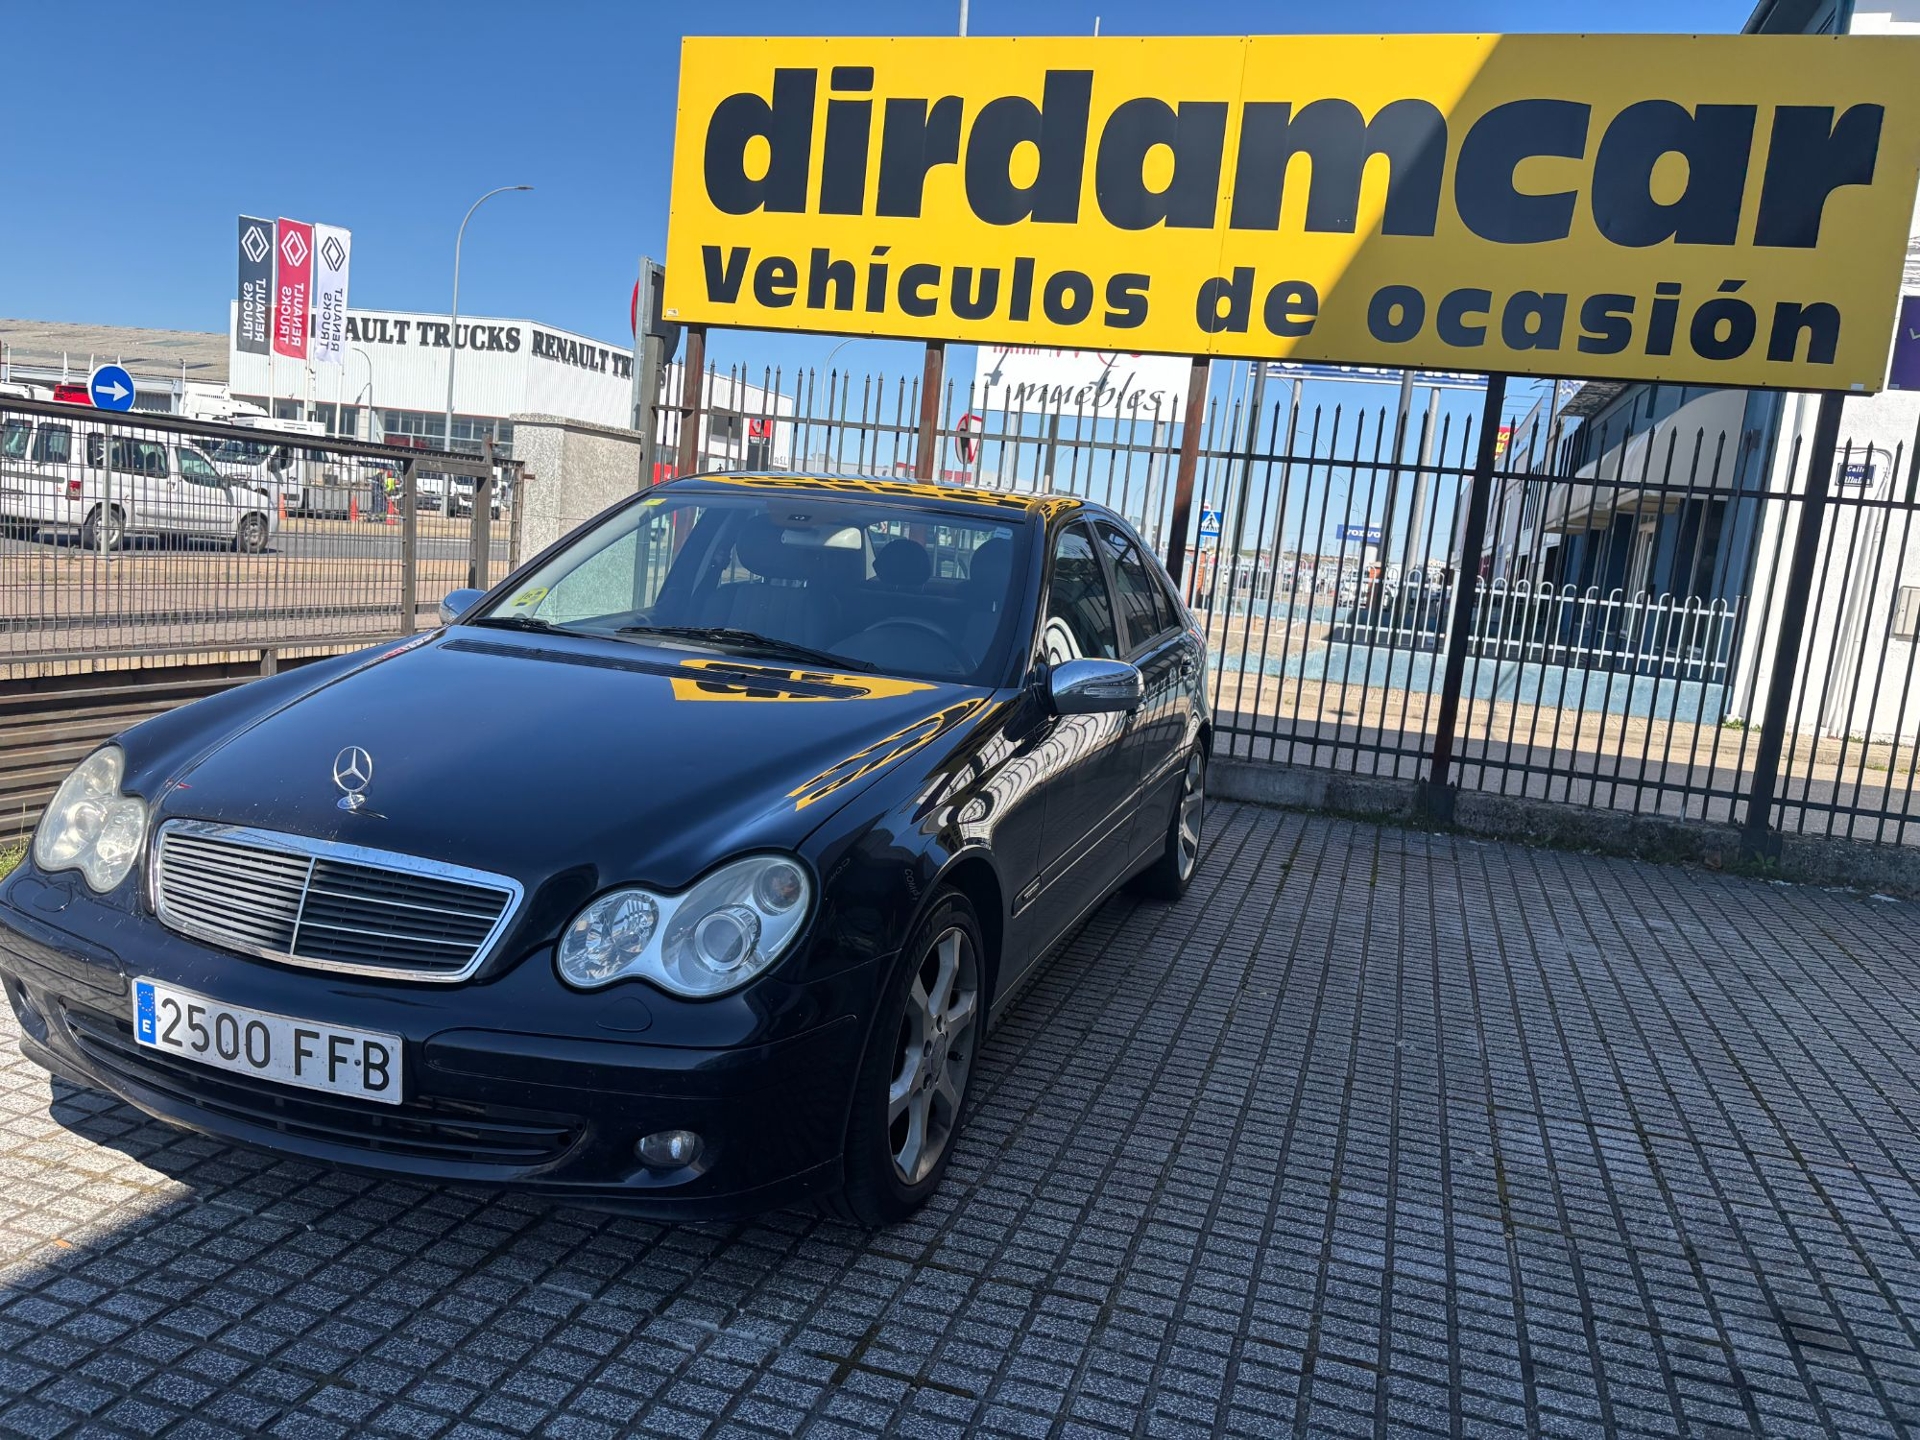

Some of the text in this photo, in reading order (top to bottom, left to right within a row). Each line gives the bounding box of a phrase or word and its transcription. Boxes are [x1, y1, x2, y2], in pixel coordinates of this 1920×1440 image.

[703, 65, 1886, 249] dirdamcar
[311, 314, 521, 353] AULT TRUCKS
[1195, 266, 1319, 337] de
[1366, 279, 1842, 365] ocasión
[532, 329, 634, 380] RENAULT TR
[1013, 370, 1166, 411] muebles
[142, 1018, 152, 1034] E
[161, 997, 390, 1092] 2500 FFB
